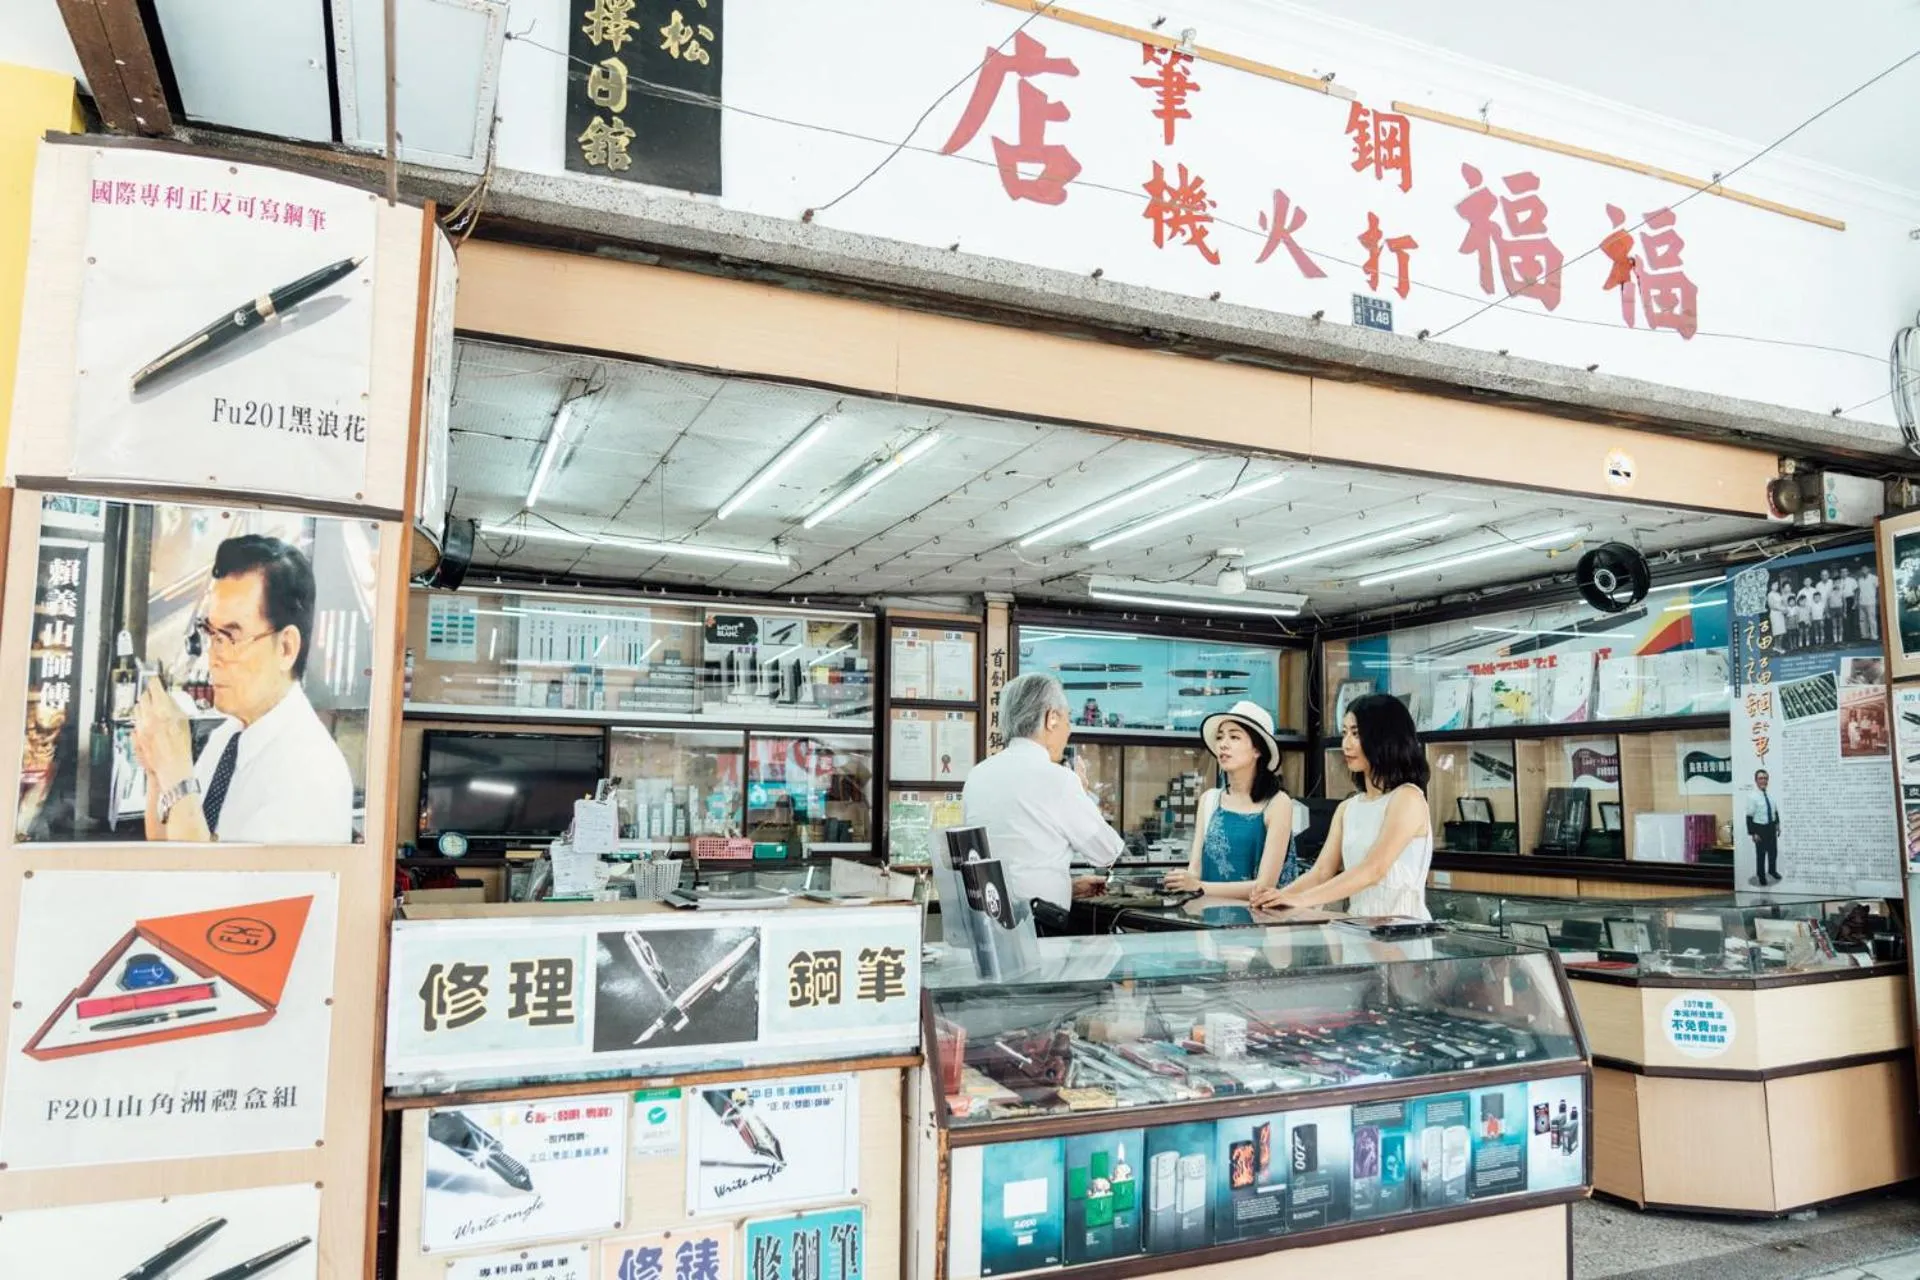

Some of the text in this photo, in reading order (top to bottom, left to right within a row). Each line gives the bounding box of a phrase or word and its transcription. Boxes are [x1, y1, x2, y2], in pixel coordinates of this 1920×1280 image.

[660, 0, 715, 66] 松
[940, 30, 1083, 206] 店
[91, 178, 328, 233] 國際專利正反可寫鋼筆
[1370, 308, 1390, 326] 148
[211, 397, 367, 444] Fu201黑浪花
[418, 945, 907, 1033] 修理 鋼筆
[714, 1162, 784, 1199] Write angle
[451, 1195, 544, 1240] Write angle
